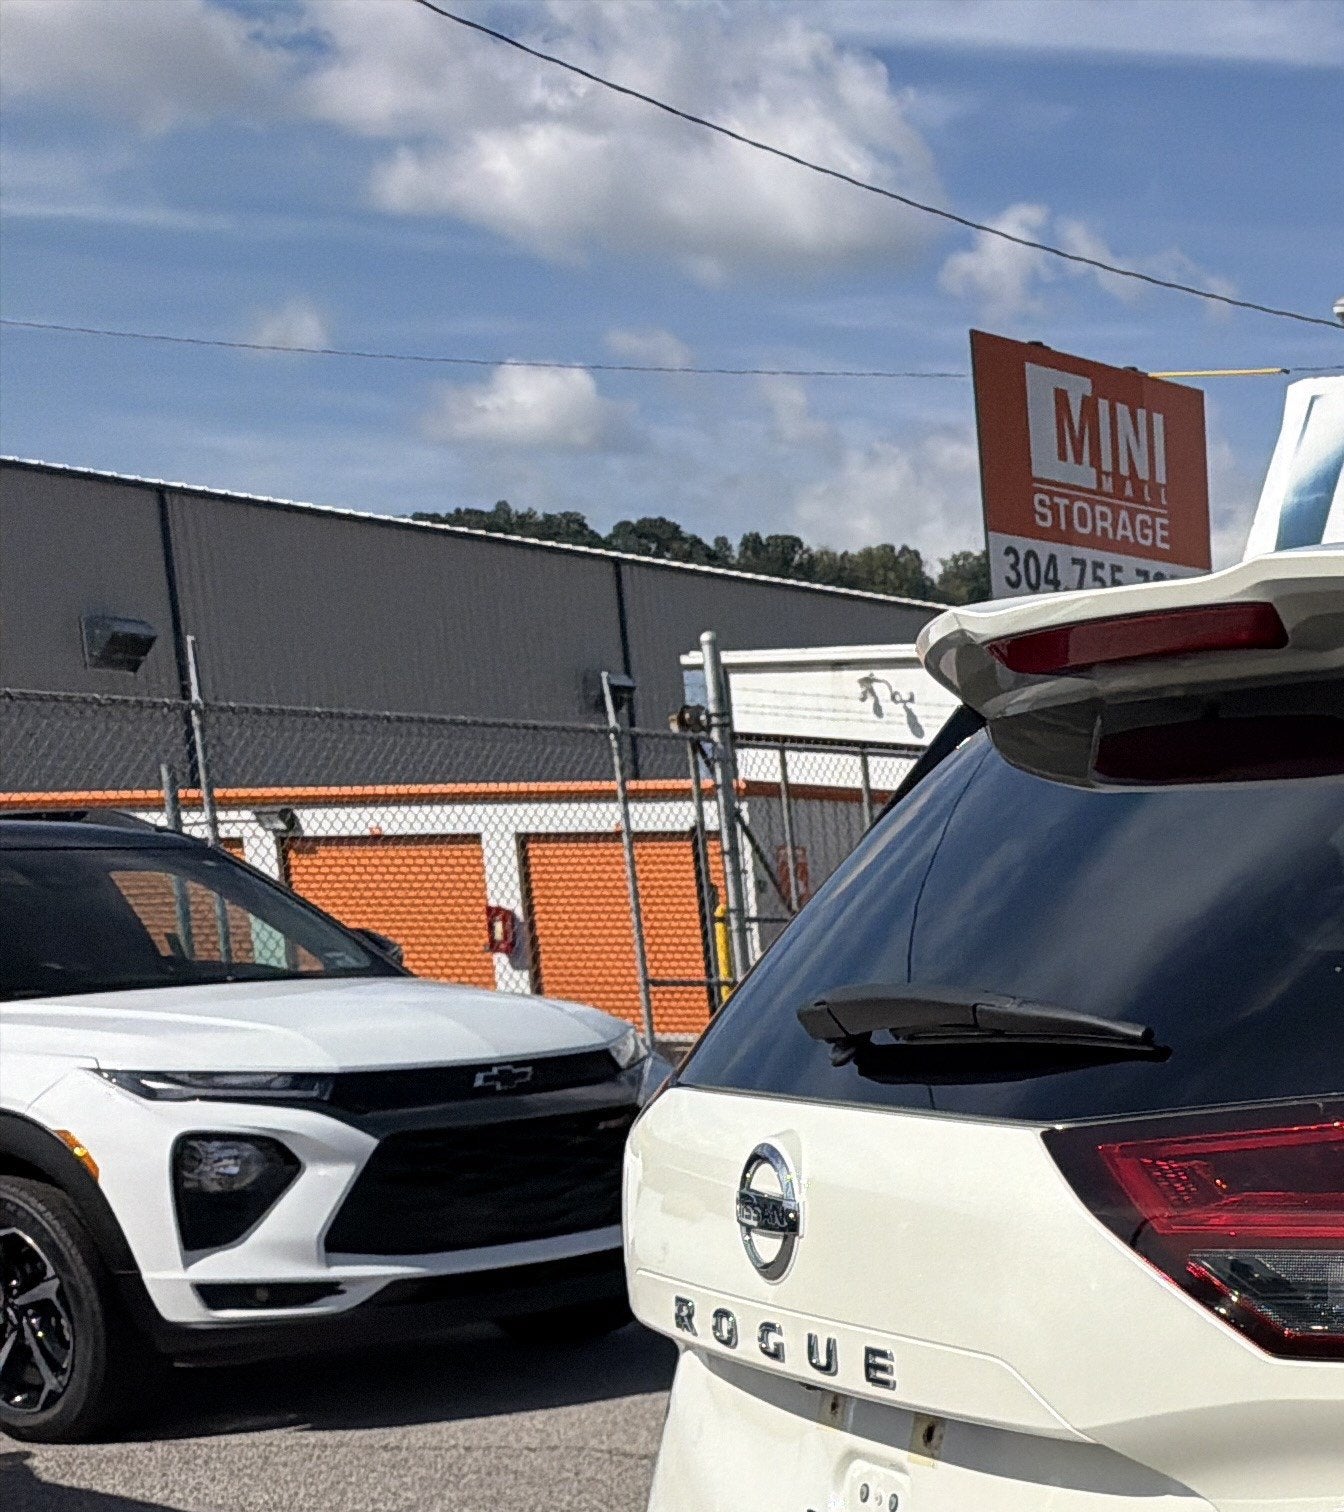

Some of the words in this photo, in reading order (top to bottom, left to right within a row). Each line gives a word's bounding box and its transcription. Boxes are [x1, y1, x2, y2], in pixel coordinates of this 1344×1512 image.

[1046, 380, 1167, 486] MINI
[1033, 493, 1170, 550] STORAGE
[674, 1296, 897, 1391] ROGUE
